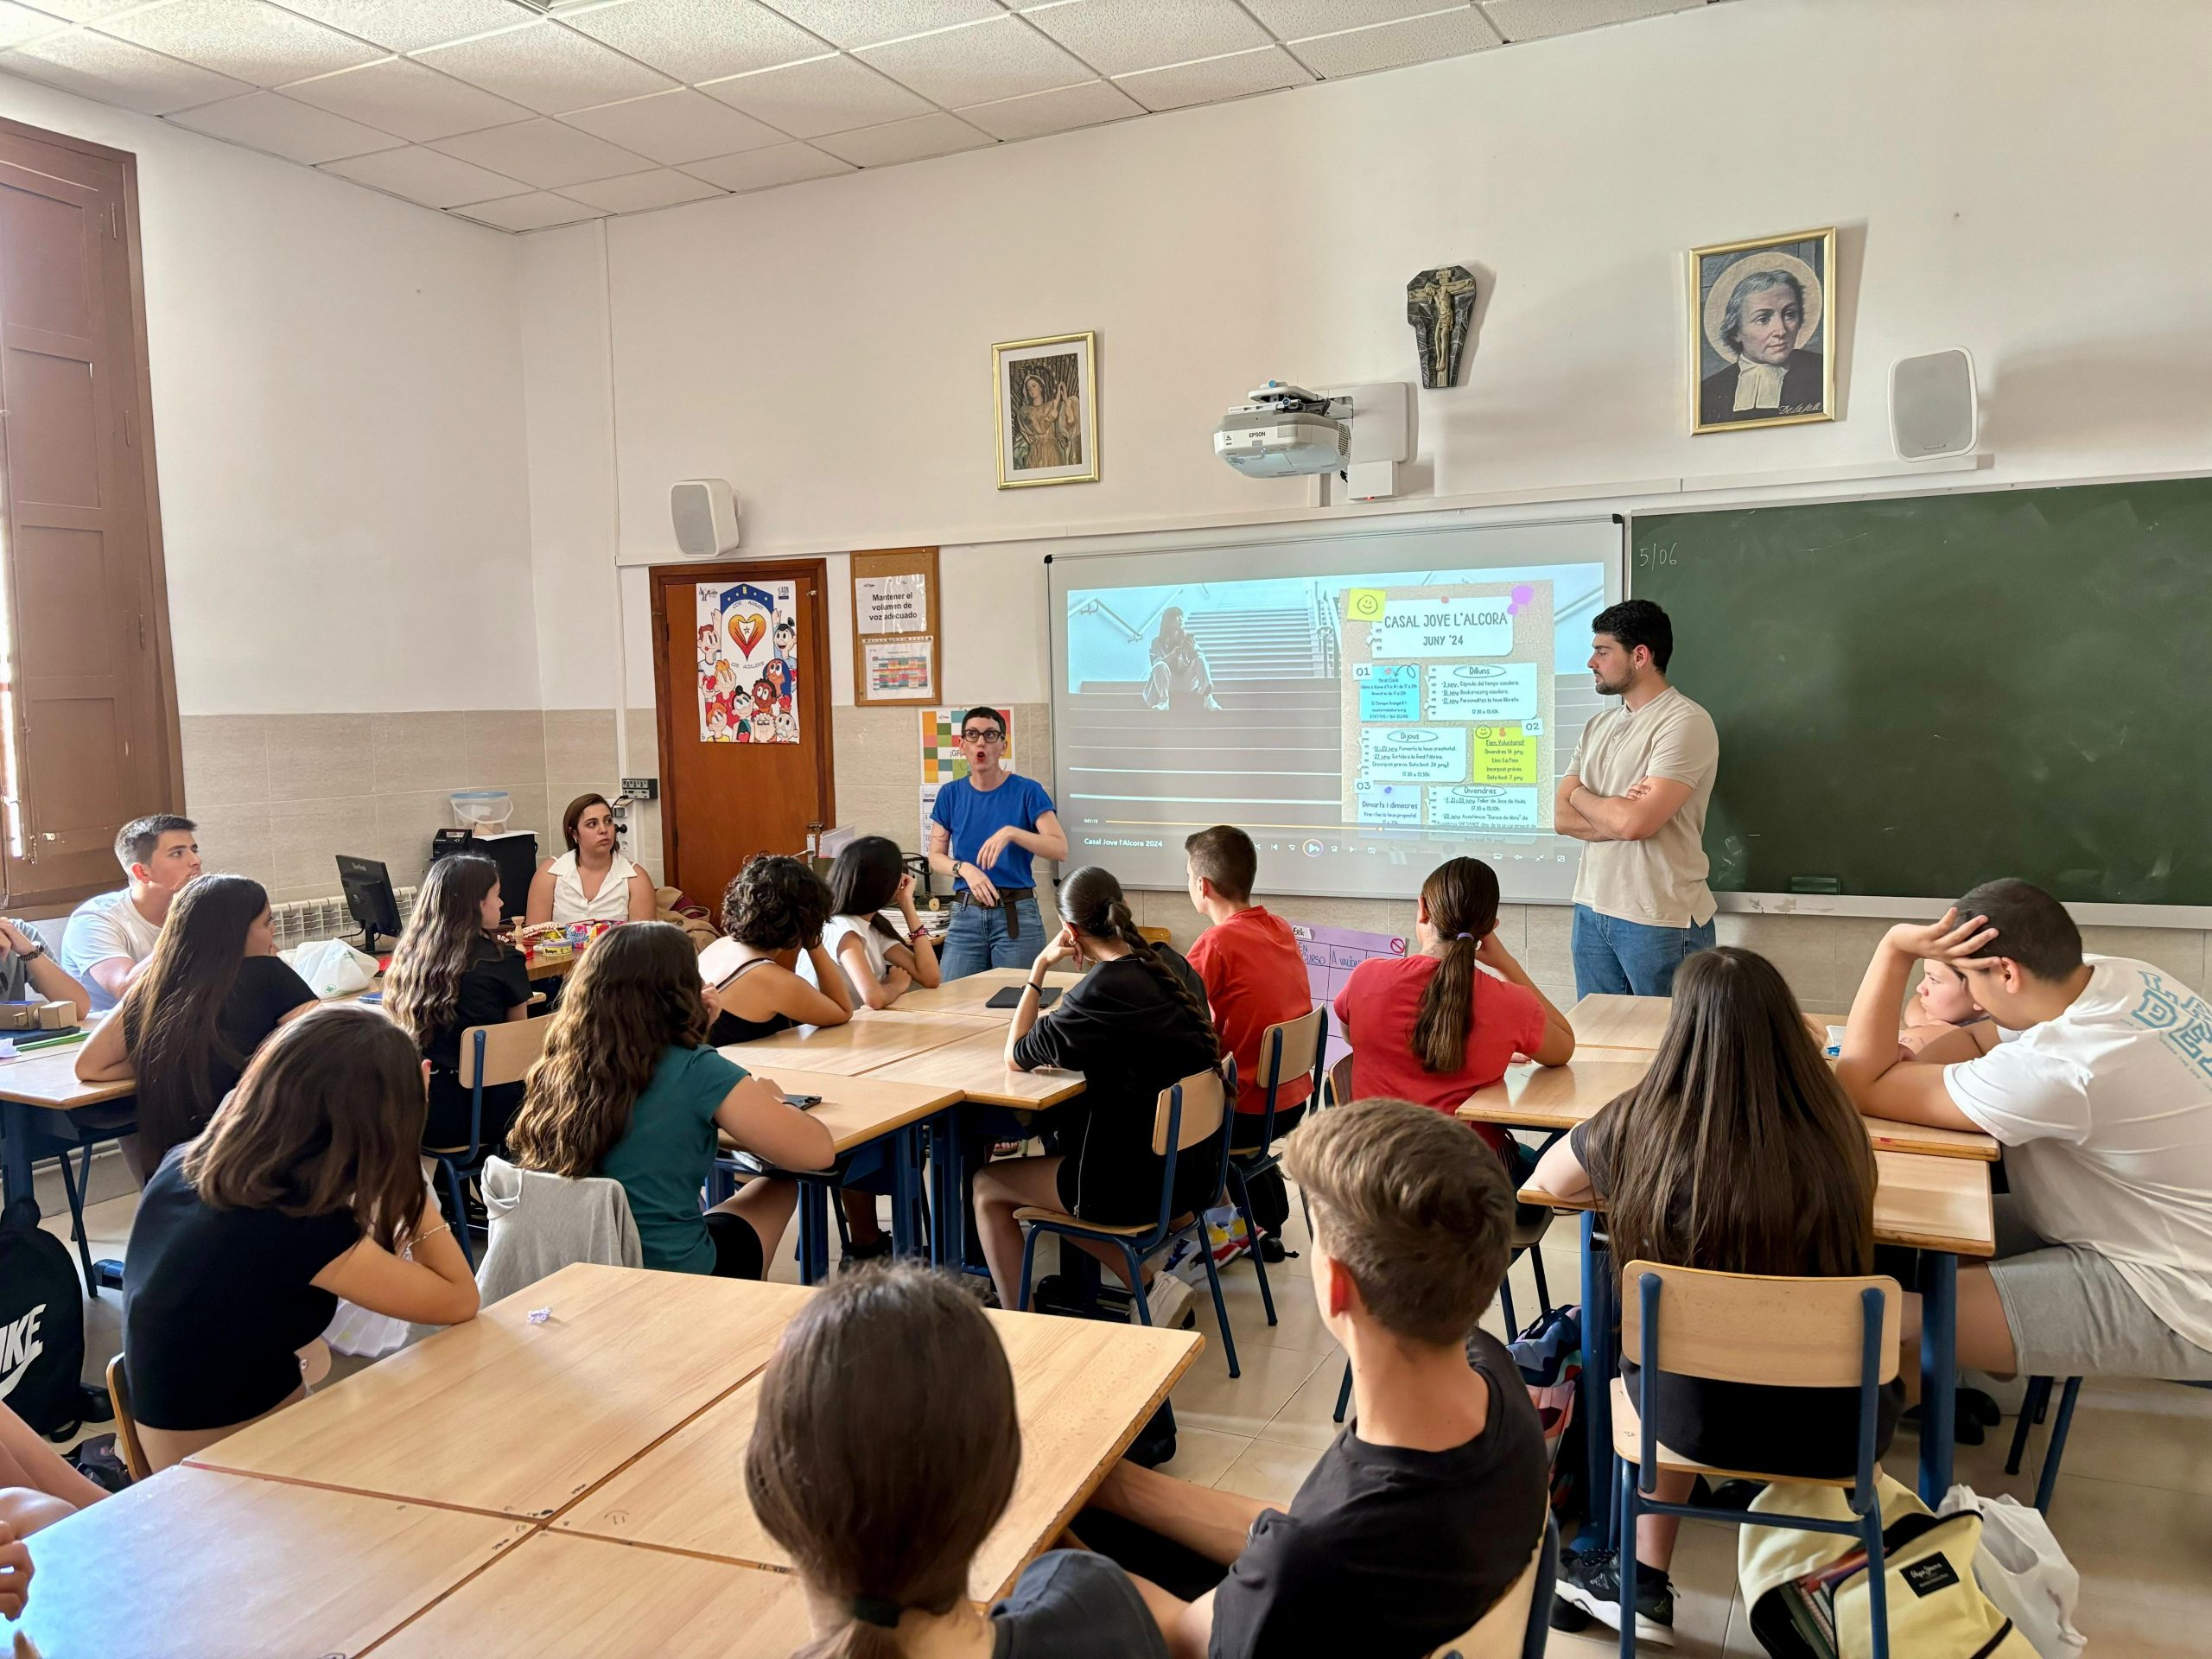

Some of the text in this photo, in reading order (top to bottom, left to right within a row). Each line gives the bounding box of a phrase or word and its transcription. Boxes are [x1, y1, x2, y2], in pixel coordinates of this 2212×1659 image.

[1639, 542, 1678, 570] 5/06
[1384, 612, 1508, 628] CASAL JOVE L'ALCORA
[1423, 636, 1446, 645] JUNY
[1357, 667, 1370, 676] 01
[1401, 732, 1420, 741] Dijous
[1332, 950, 1337, 964] A
